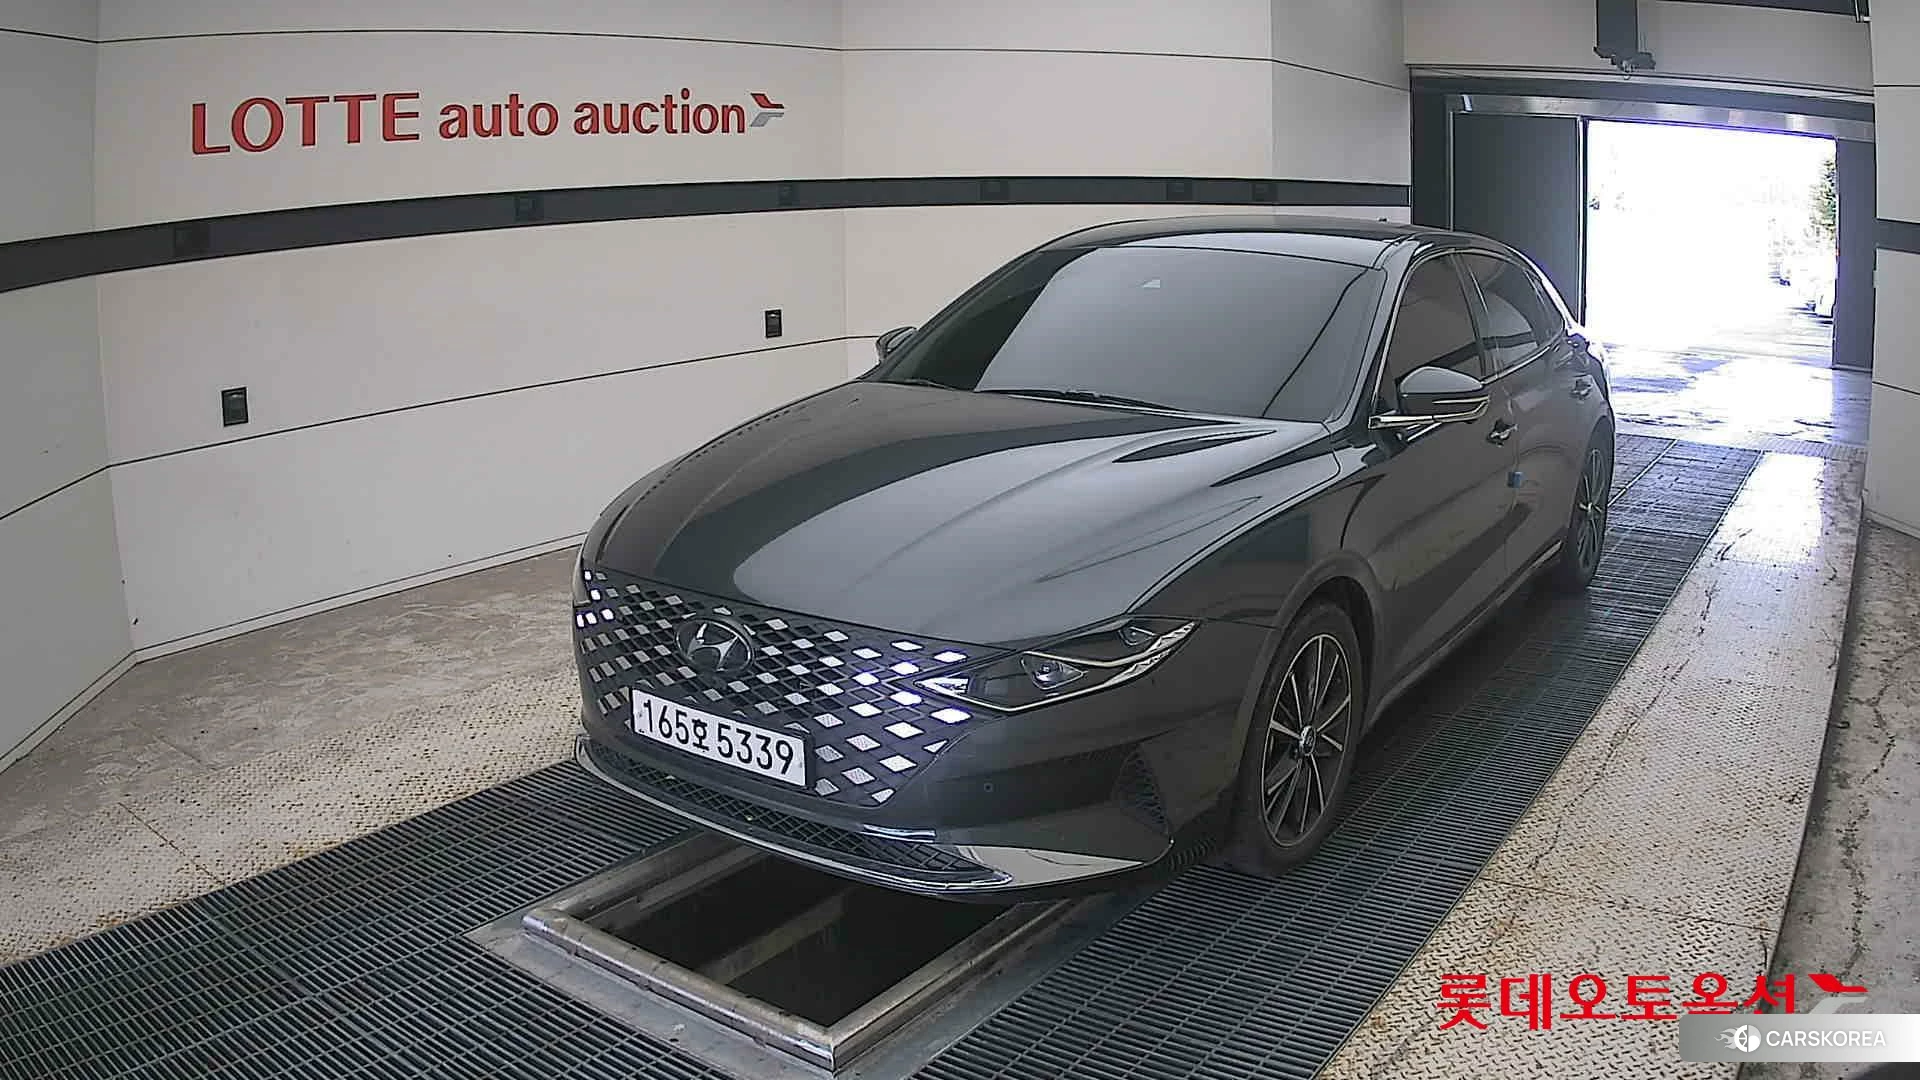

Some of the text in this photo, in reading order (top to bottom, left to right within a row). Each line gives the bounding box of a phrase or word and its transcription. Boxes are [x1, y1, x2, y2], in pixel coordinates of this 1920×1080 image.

[192, 88, 746, 155] LOTTE auto auction
[643, 699, 794, 775] 165호 5339
